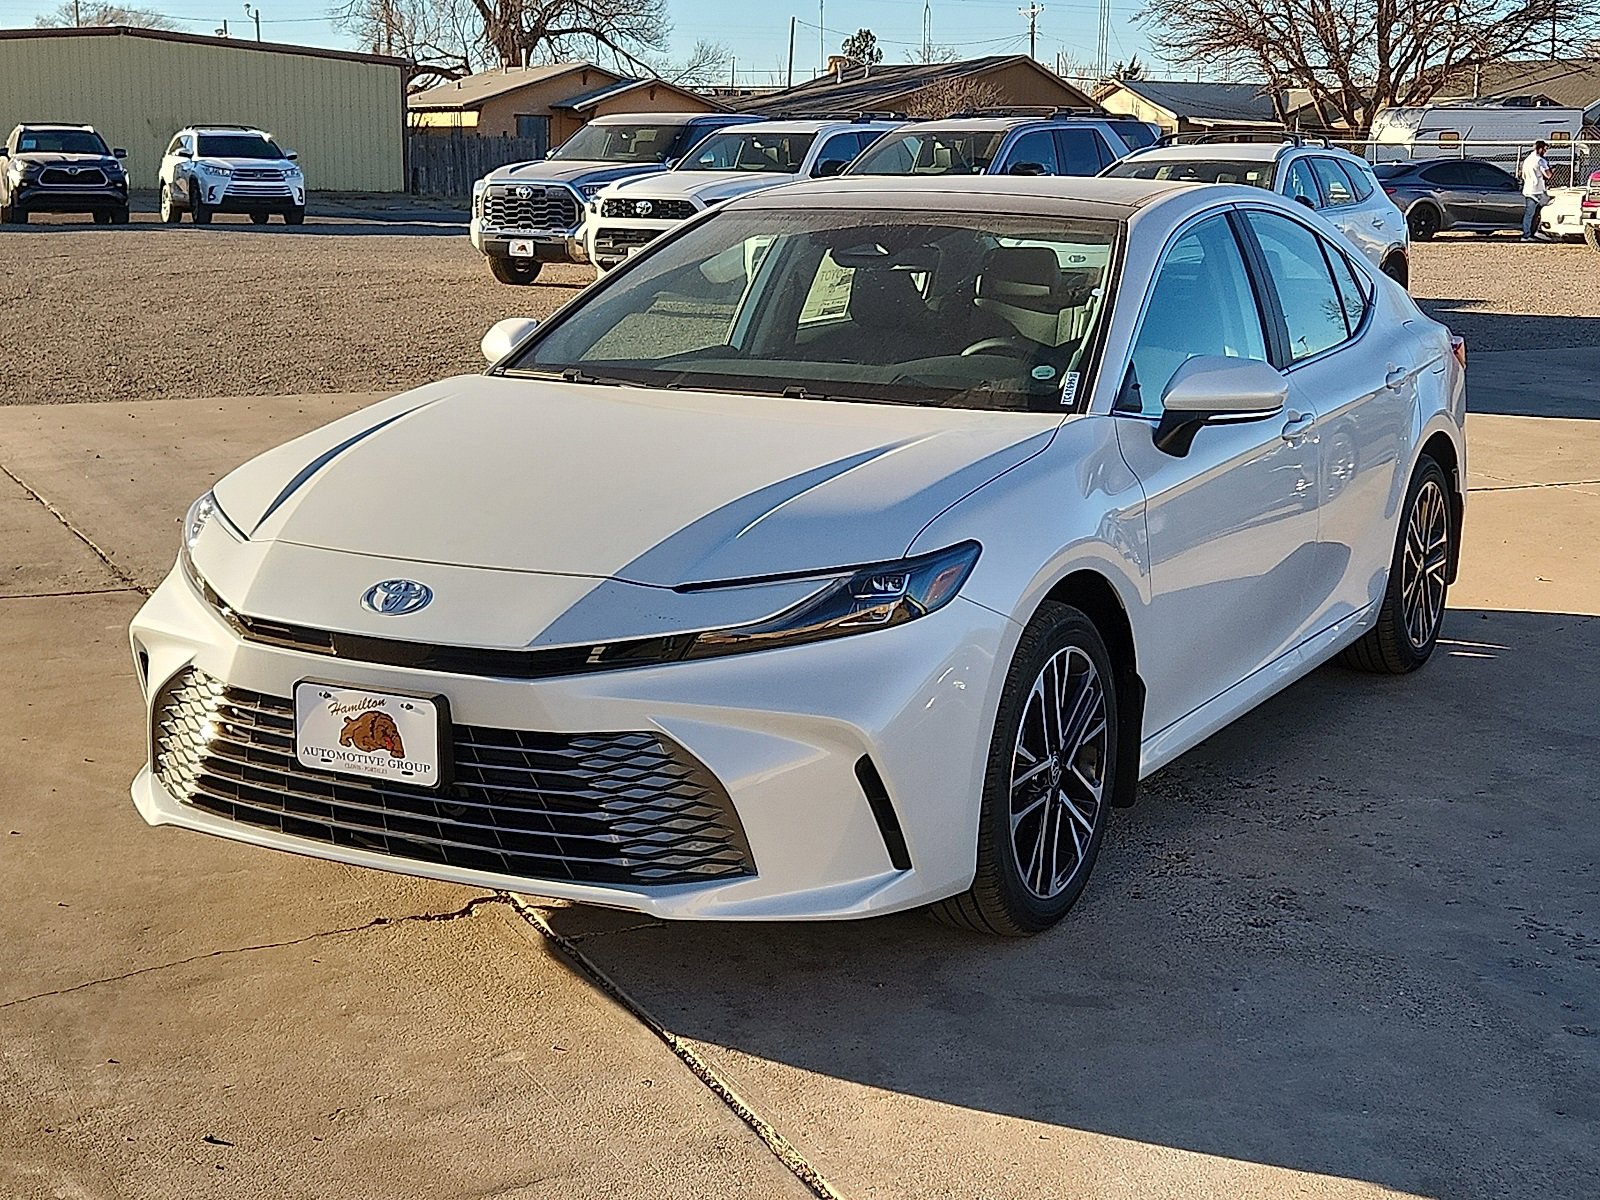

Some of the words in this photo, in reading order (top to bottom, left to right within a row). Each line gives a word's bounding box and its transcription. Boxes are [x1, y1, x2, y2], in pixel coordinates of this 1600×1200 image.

[328, 696, 387, 716] Hamilton
[302, 746, 385, 767] AUTOMOTIVE
[387, 759, 431, 774] GROUP
